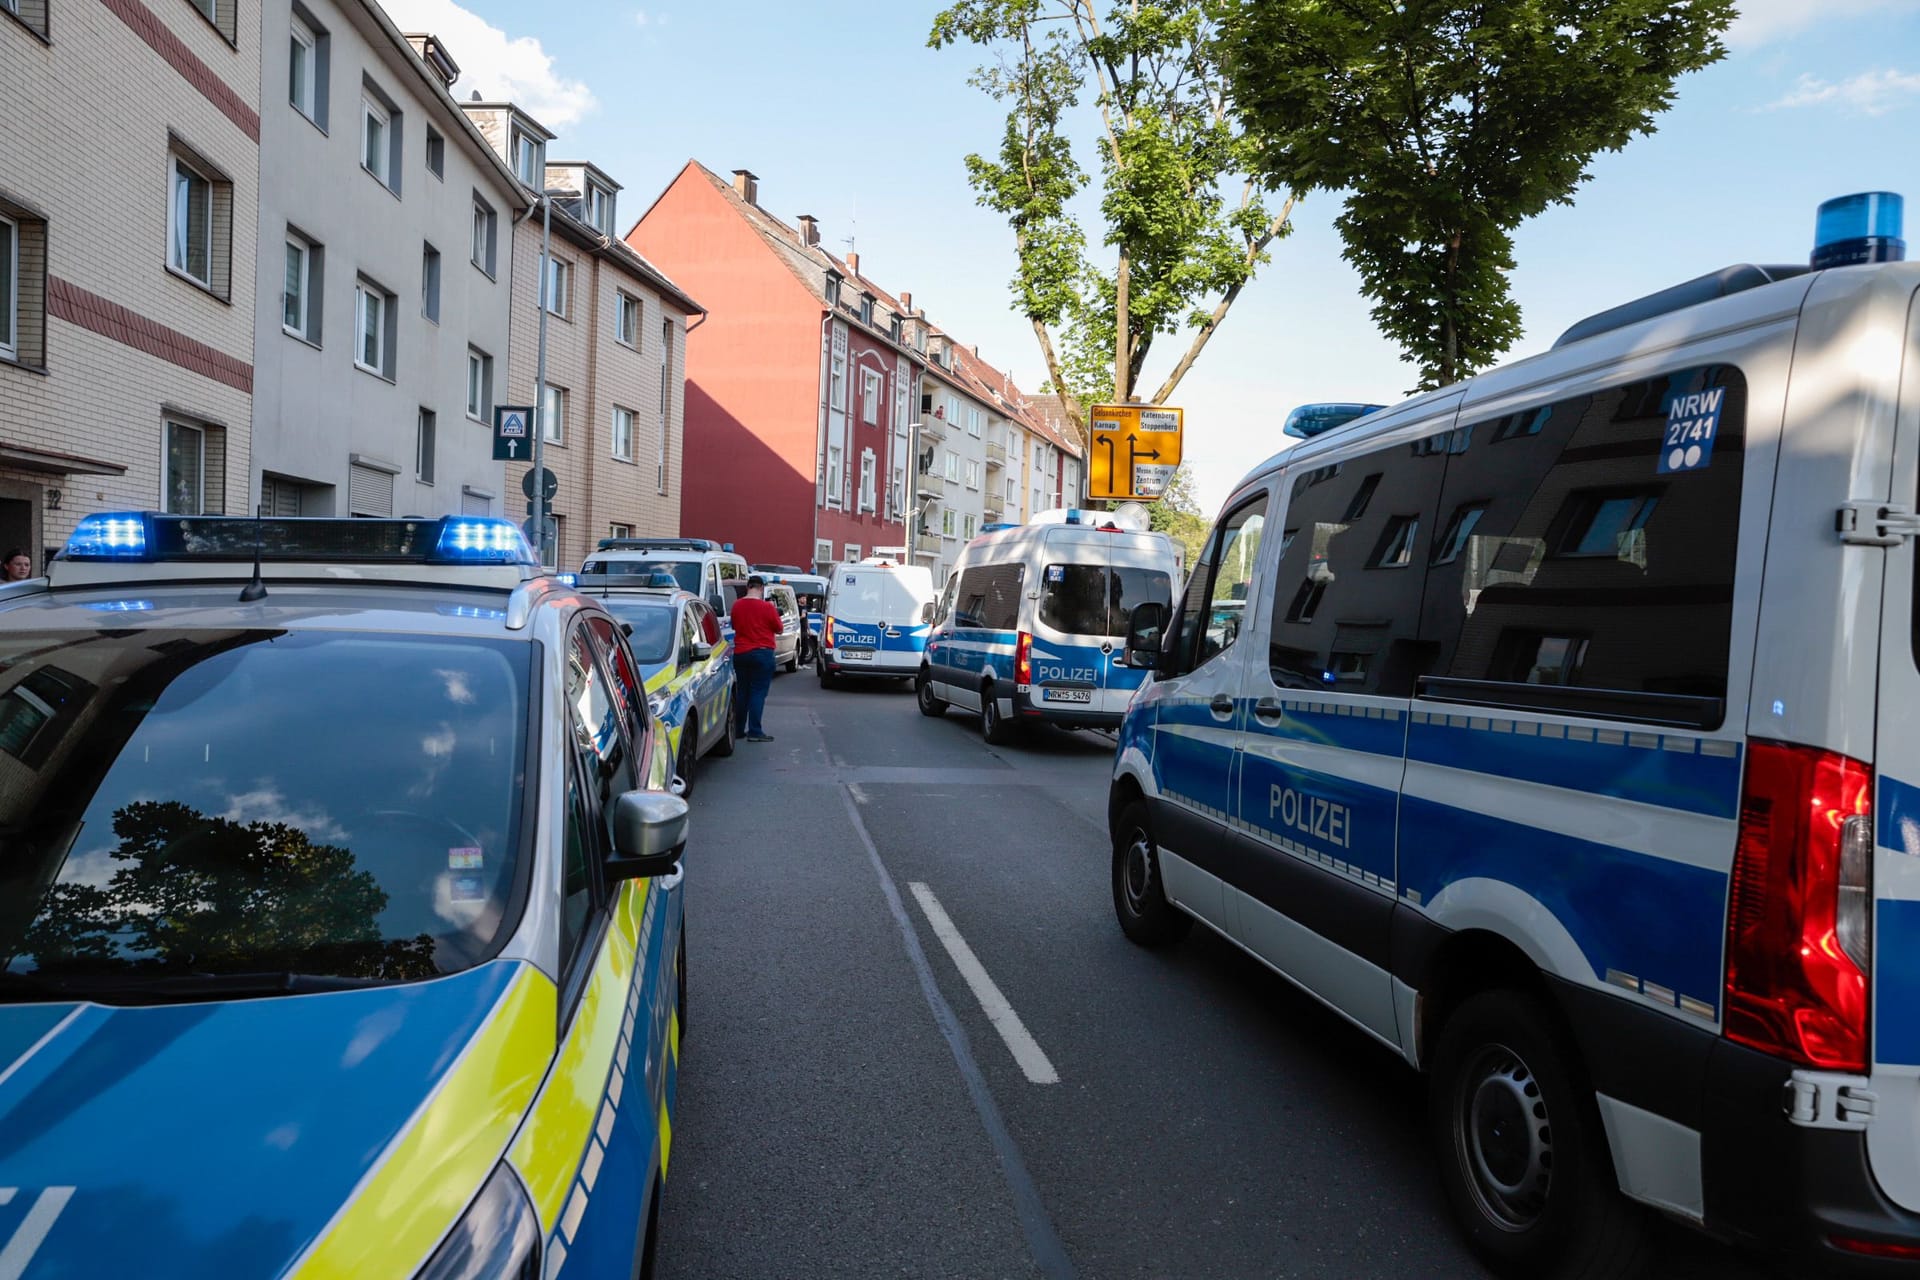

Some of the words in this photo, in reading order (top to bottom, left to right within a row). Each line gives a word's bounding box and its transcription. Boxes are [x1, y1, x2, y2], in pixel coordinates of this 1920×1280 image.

[1670, 389, 1722, 420] NRW
[1141, 411, 1175, 420] Katernberg
[1094, 422, 1116, 430] Karnap
[1140, 422, 1178, 431] Stoppenberg
[1667, 416, 1714, 445] 2741
[1136, 475, 1161, 484] Zentrum
[838, 634, 876, 644] POLIZEI
[1040, 666, 1097, 681] POLIZEI
[1269, 783, 1350, 849] POLIZEI
